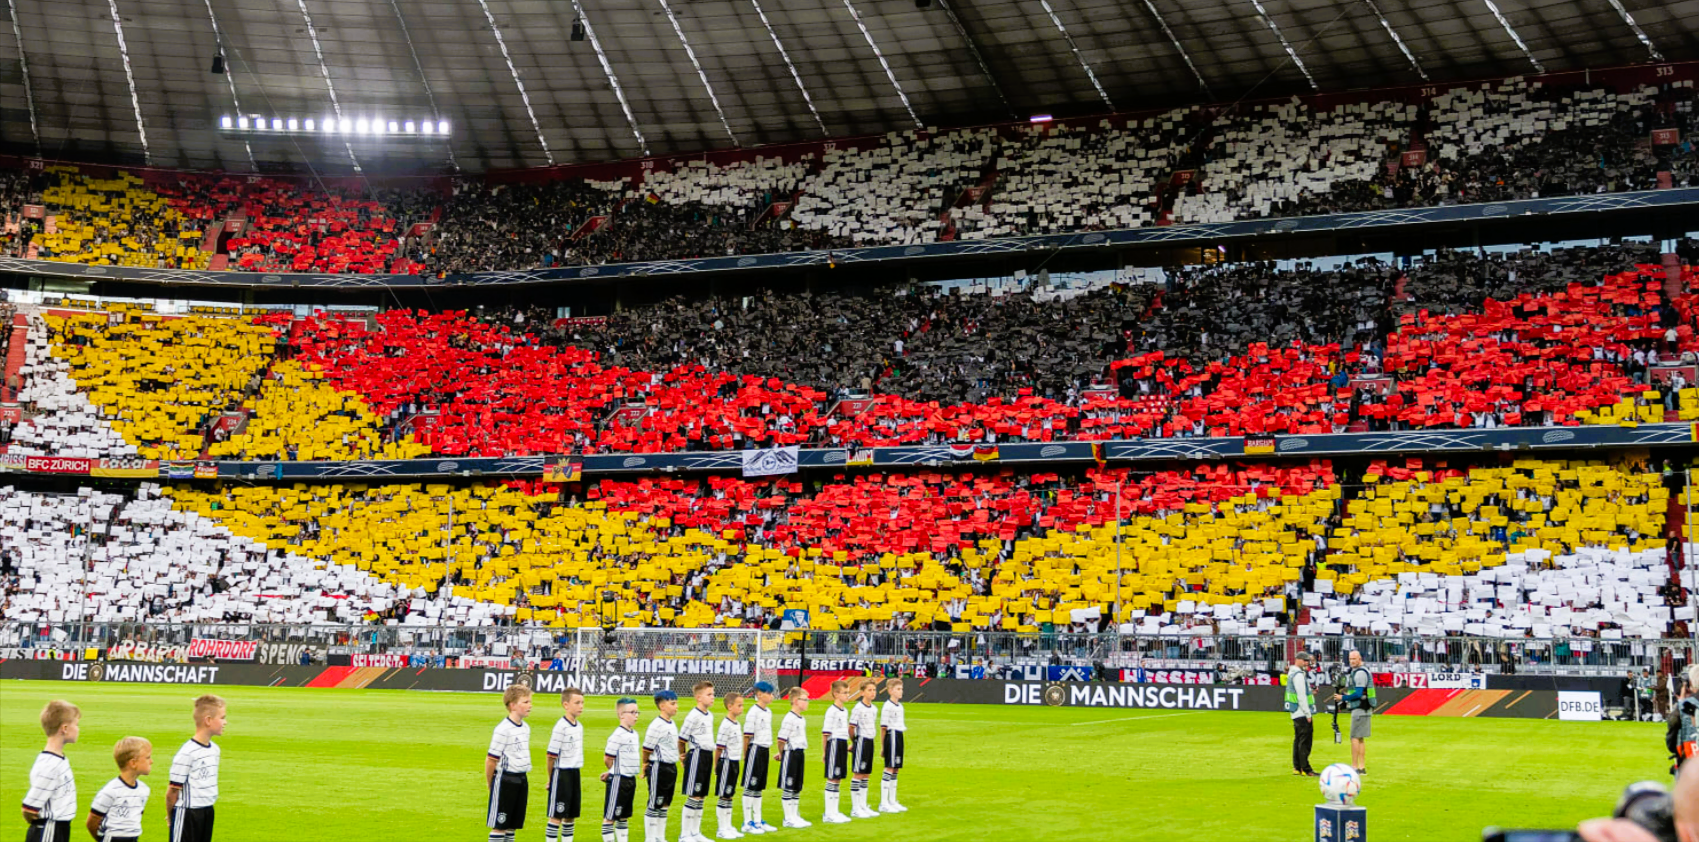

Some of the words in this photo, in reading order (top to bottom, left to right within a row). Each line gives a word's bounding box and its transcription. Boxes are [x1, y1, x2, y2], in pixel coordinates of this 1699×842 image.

[1656, 66, 1674, 77] 313
[30, 160, 43, 170] 321
[28, 458, 49, 469] BFC
[50, 458, 89, 471] ZÜRICH
[189, 638, 257, 659] ROHRDORF
[62, 663, 88, 680] DIE
[105, 664, 219, 684] MANNSCHAFT
[625, 658, 749, 675] HOCKENHEIM
[483, 672, 515, 690] DIE
[536, 673, 675, 694] MANNSCHAFT
[1393, 673, 1427, 688] DIEZ
[1004, 683, 1042, 704] DIE
[1070, 684, 1244, 709] MANNSCHAFT
[1560, 701, 1600, 713] DFB.DE
